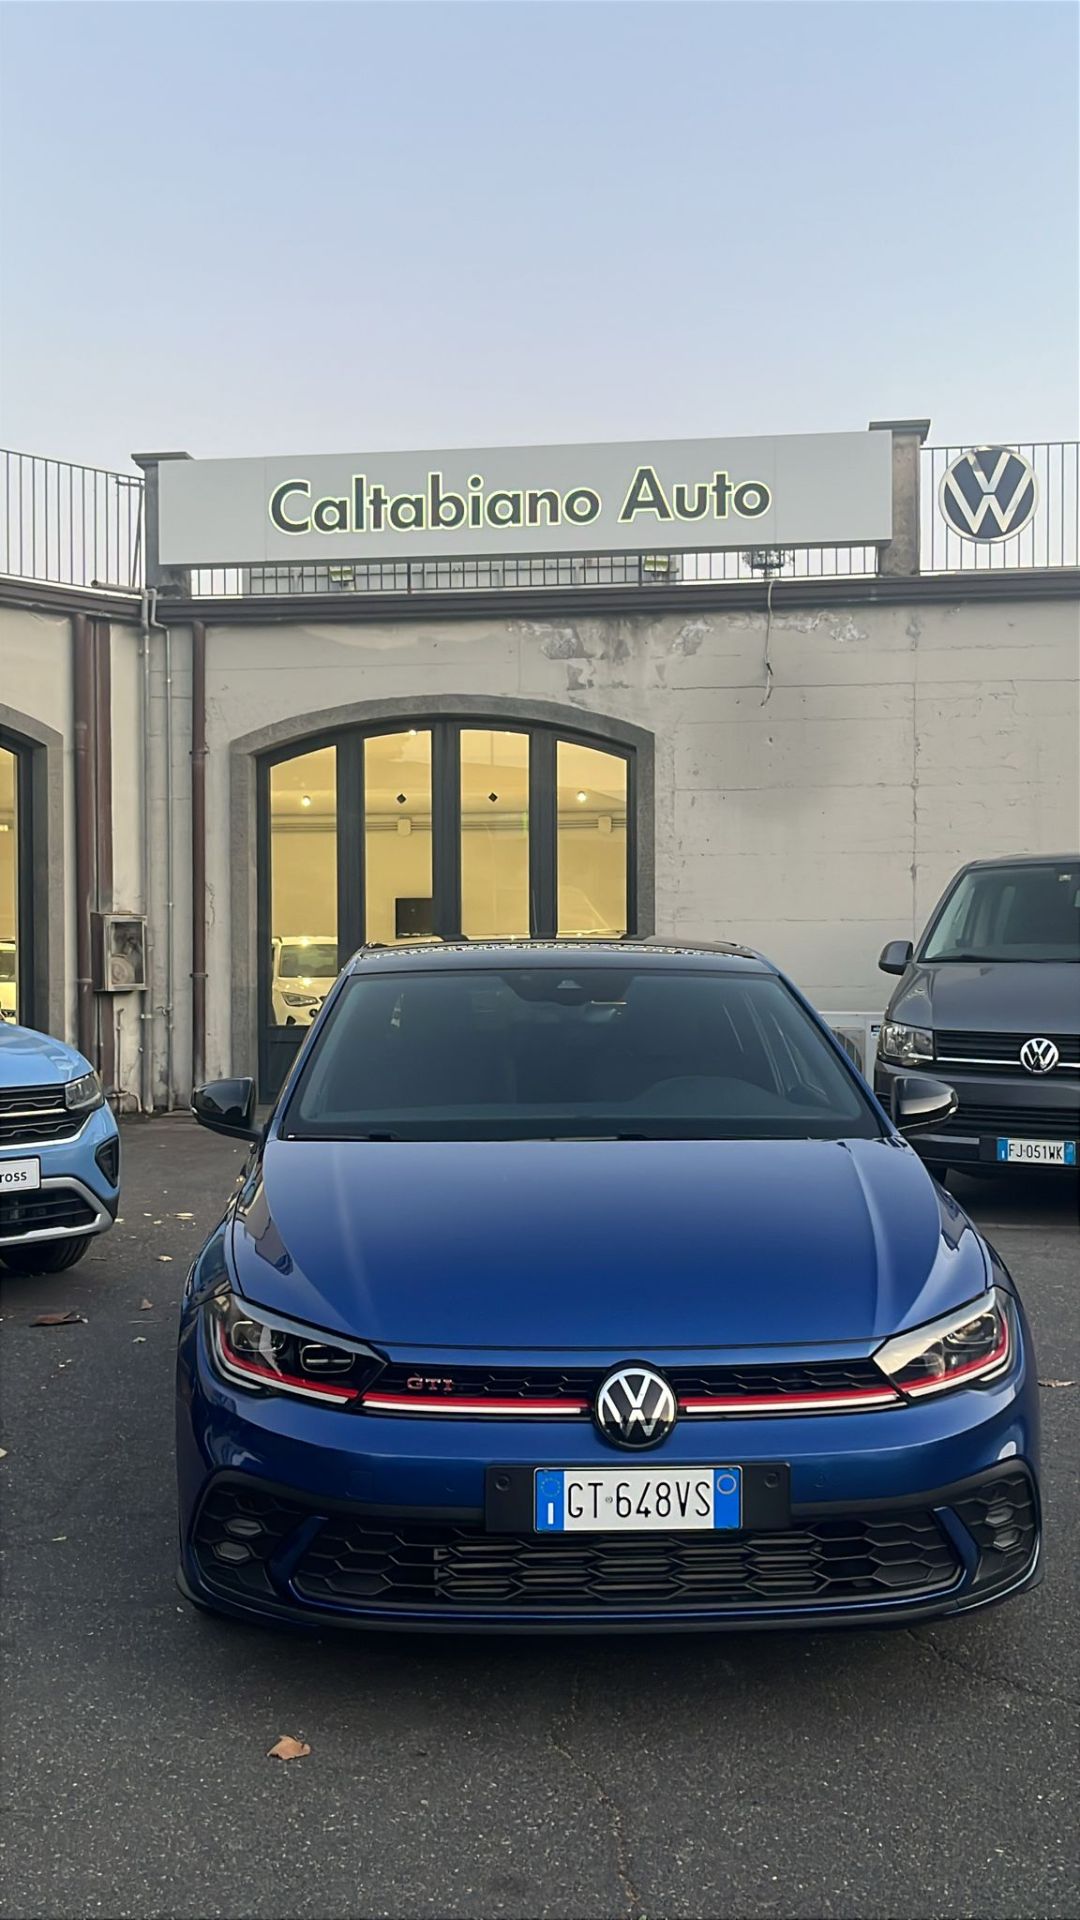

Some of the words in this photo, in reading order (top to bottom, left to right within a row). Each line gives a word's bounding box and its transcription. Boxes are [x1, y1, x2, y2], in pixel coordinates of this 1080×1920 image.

[268, 471, 602, 535] Caltabiano
[617, 465, 772, 524] Auto
[943, 448, 1035, 536] VW
[407, 1377, 453, 1391] GTI
[601, 1371, 672, 1438] VW
